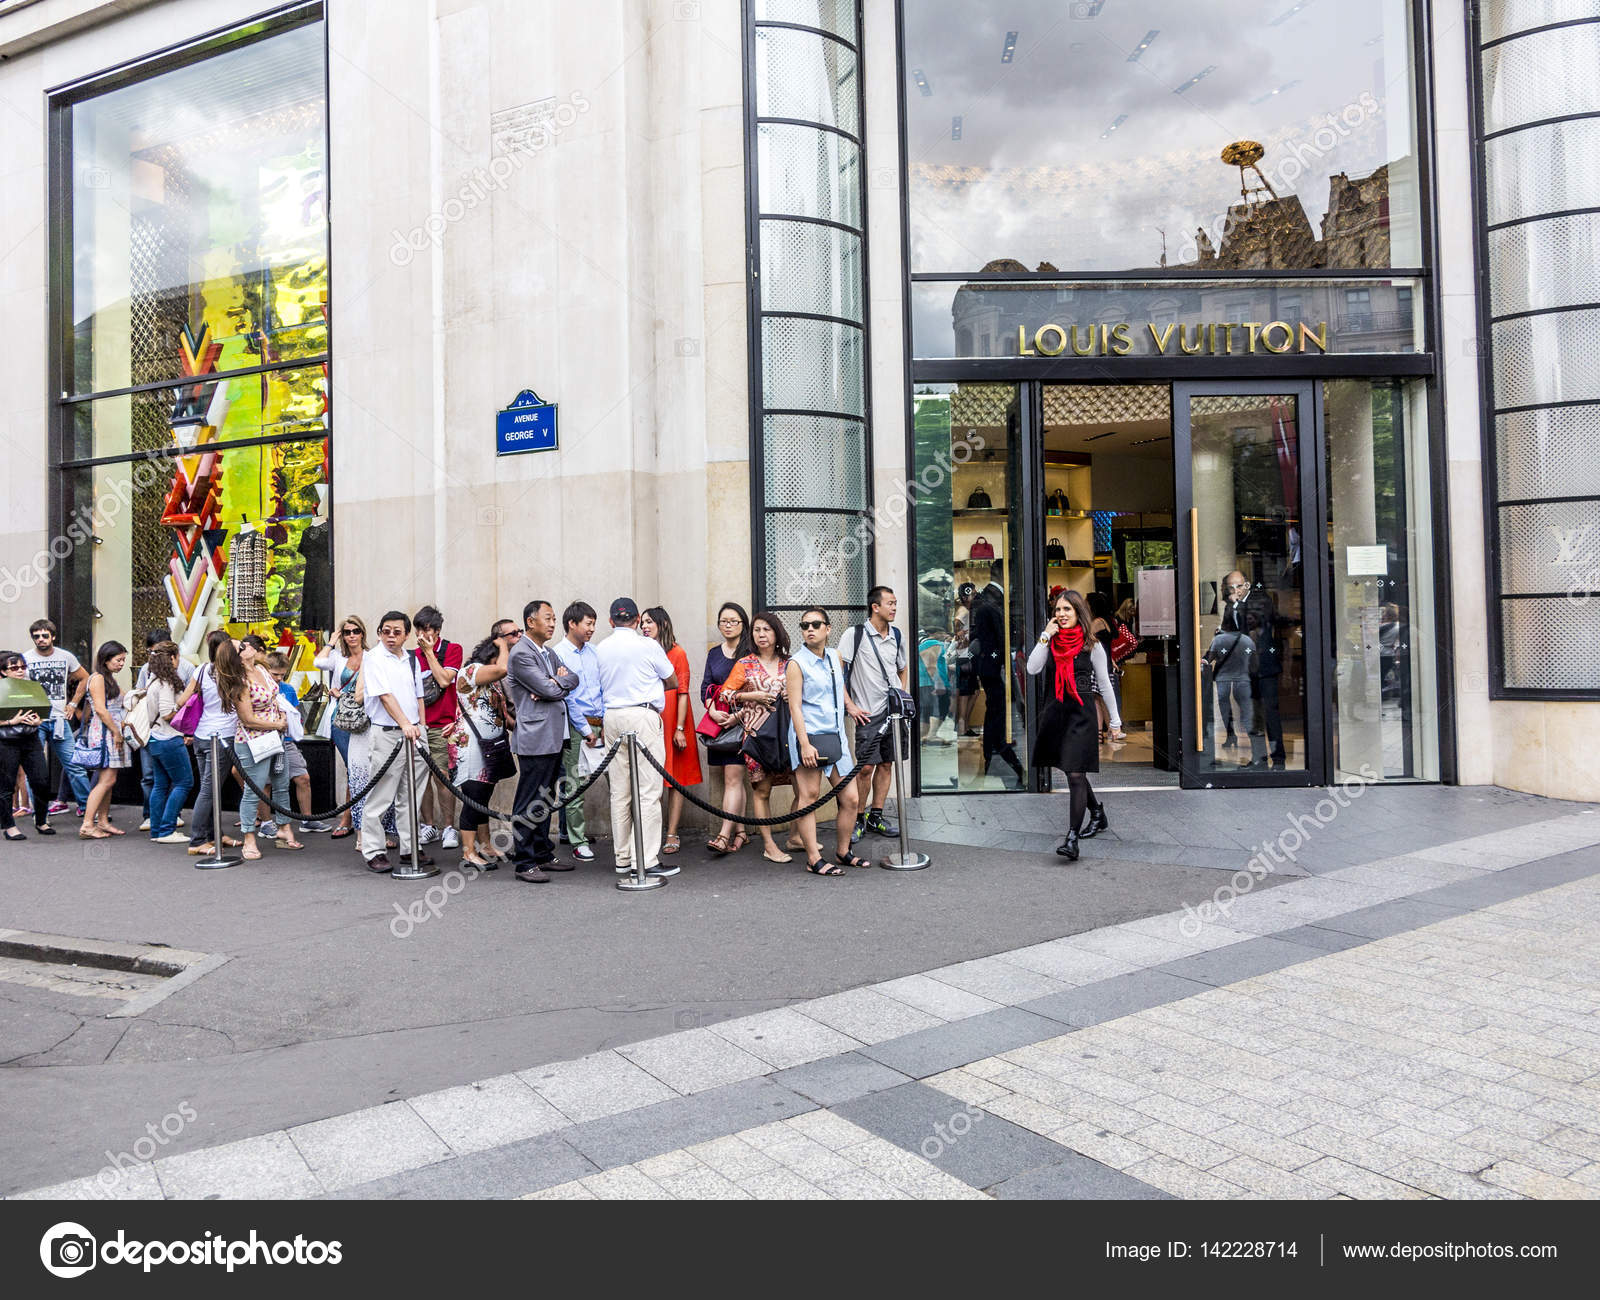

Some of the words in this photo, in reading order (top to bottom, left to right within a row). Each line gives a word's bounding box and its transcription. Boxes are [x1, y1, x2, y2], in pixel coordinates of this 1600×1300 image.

[1018, 323, 1134, 356] LOUIS
[1148, 321, 1327, 355] VUITTON
[514, 413, 538, 423] AVENUE
[505, 430, 534, 441] GEORGE
[542, 428, 548, 437] V
[28, 661, 66, 670] RAMONES
